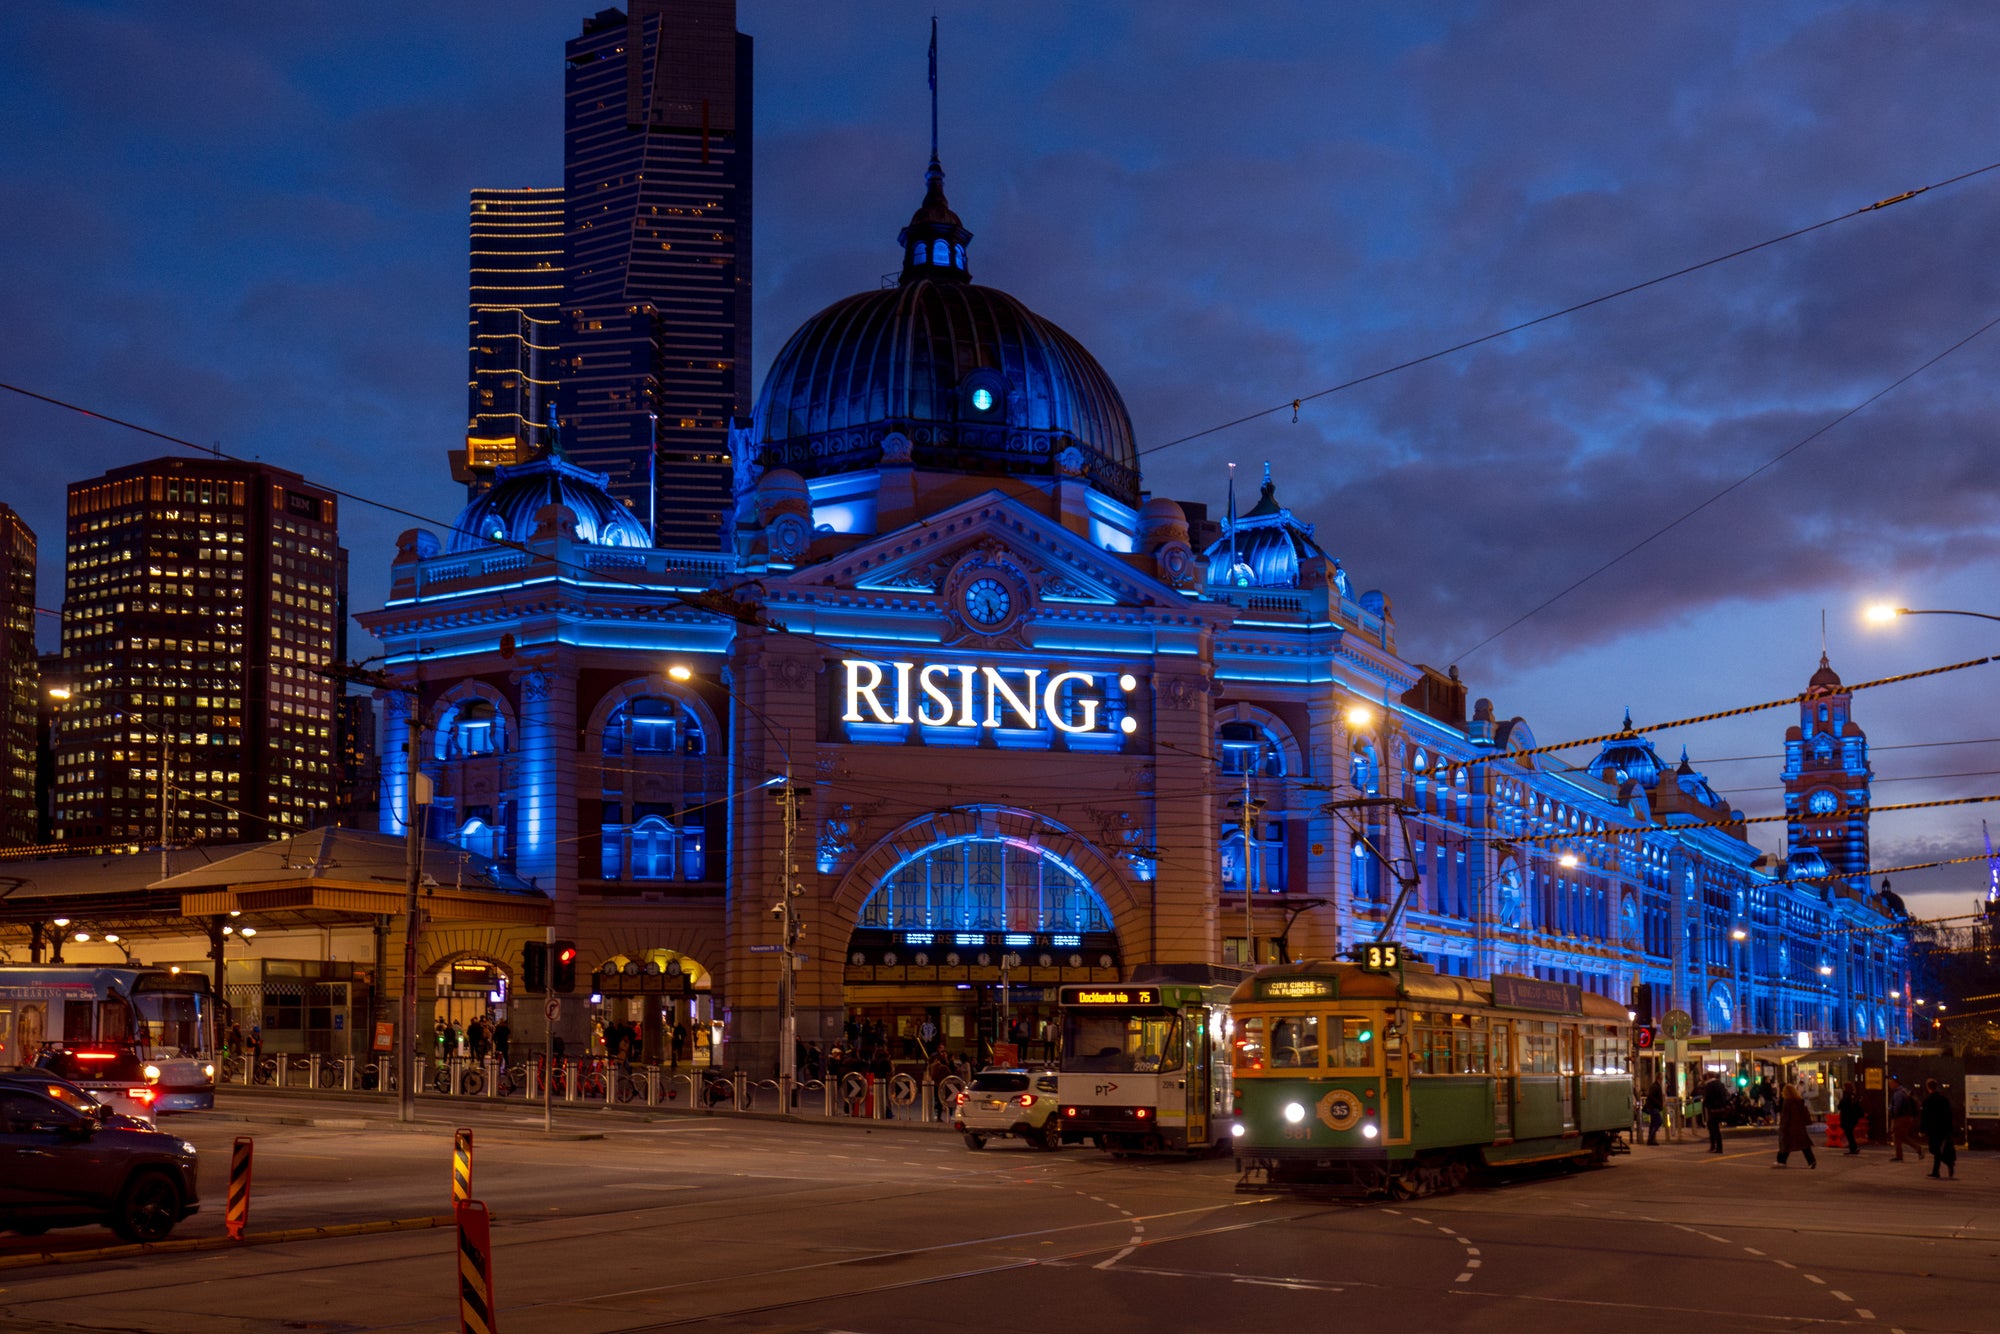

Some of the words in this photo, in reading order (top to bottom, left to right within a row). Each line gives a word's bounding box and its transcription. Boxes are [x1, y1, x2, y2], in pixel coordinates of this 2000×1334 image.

[291, 495, 310, 511] IBM
[1369, 946, 1396, 967] 35
[1289, 980, 1315, 989] CIRCLE
[10, 989, 62, 998] CLEARING
[1078, 991, 1115, 1003] Docklands
[1116, 991, 1128, 1003] via
[1139, 991, 1150, 1003] 75
[1333, 1105, 1348, 1116] 35
